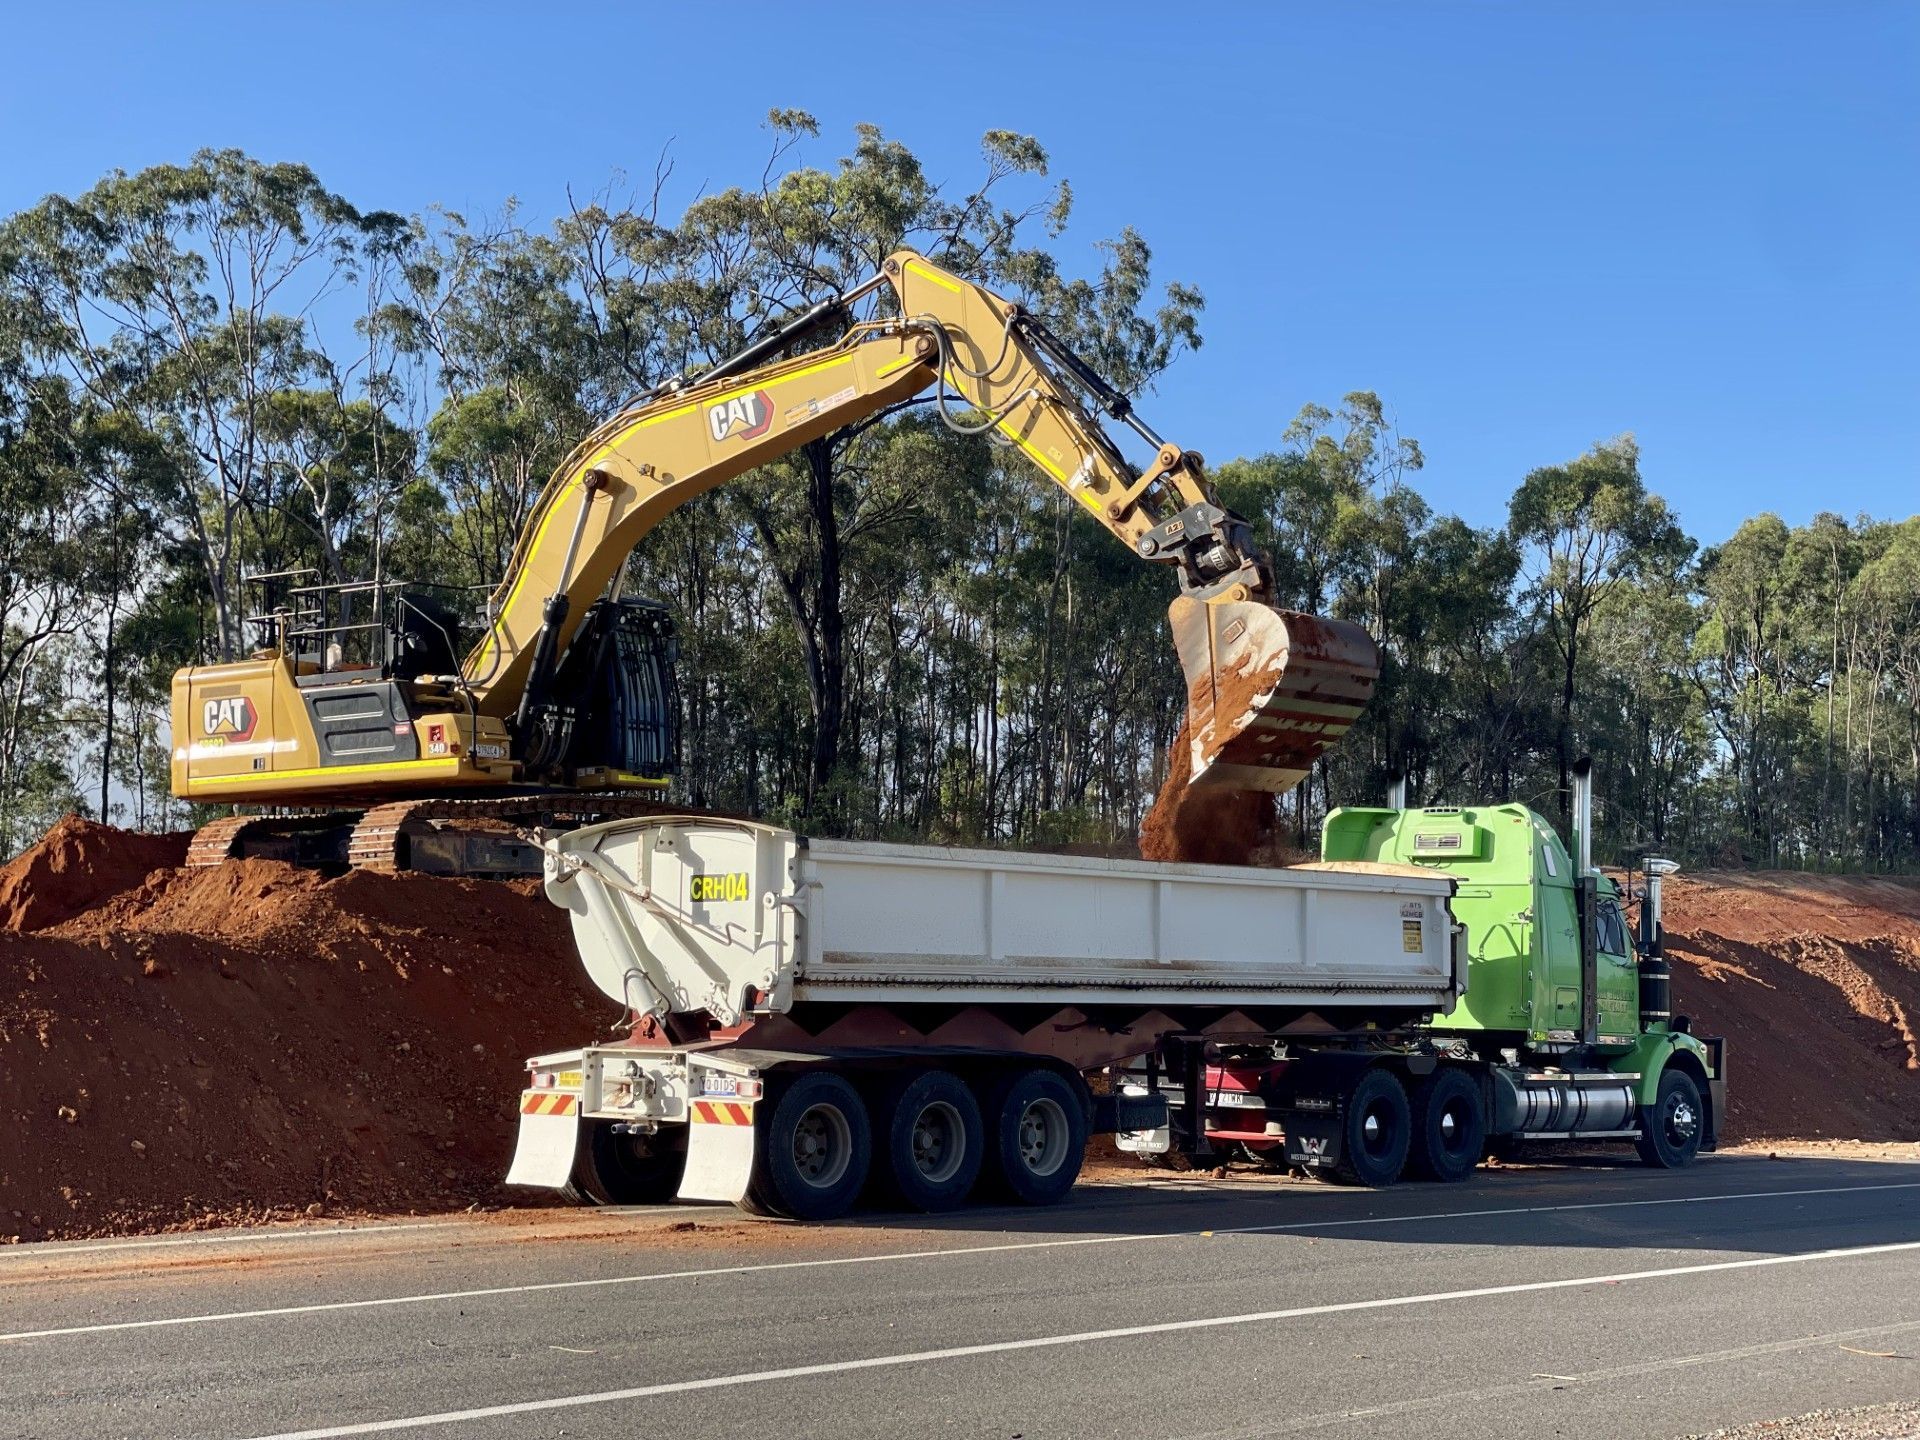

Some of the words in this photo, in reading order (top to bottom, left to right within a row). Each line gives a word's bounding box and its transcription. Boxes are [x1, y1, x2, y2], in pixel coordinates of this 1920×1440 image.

[709, 391, 757, 441] CAT
[204, 697, 245, 734] CAT
[429, 743, 445, 754] 340
[691, 872, 747, 902] CRH04
